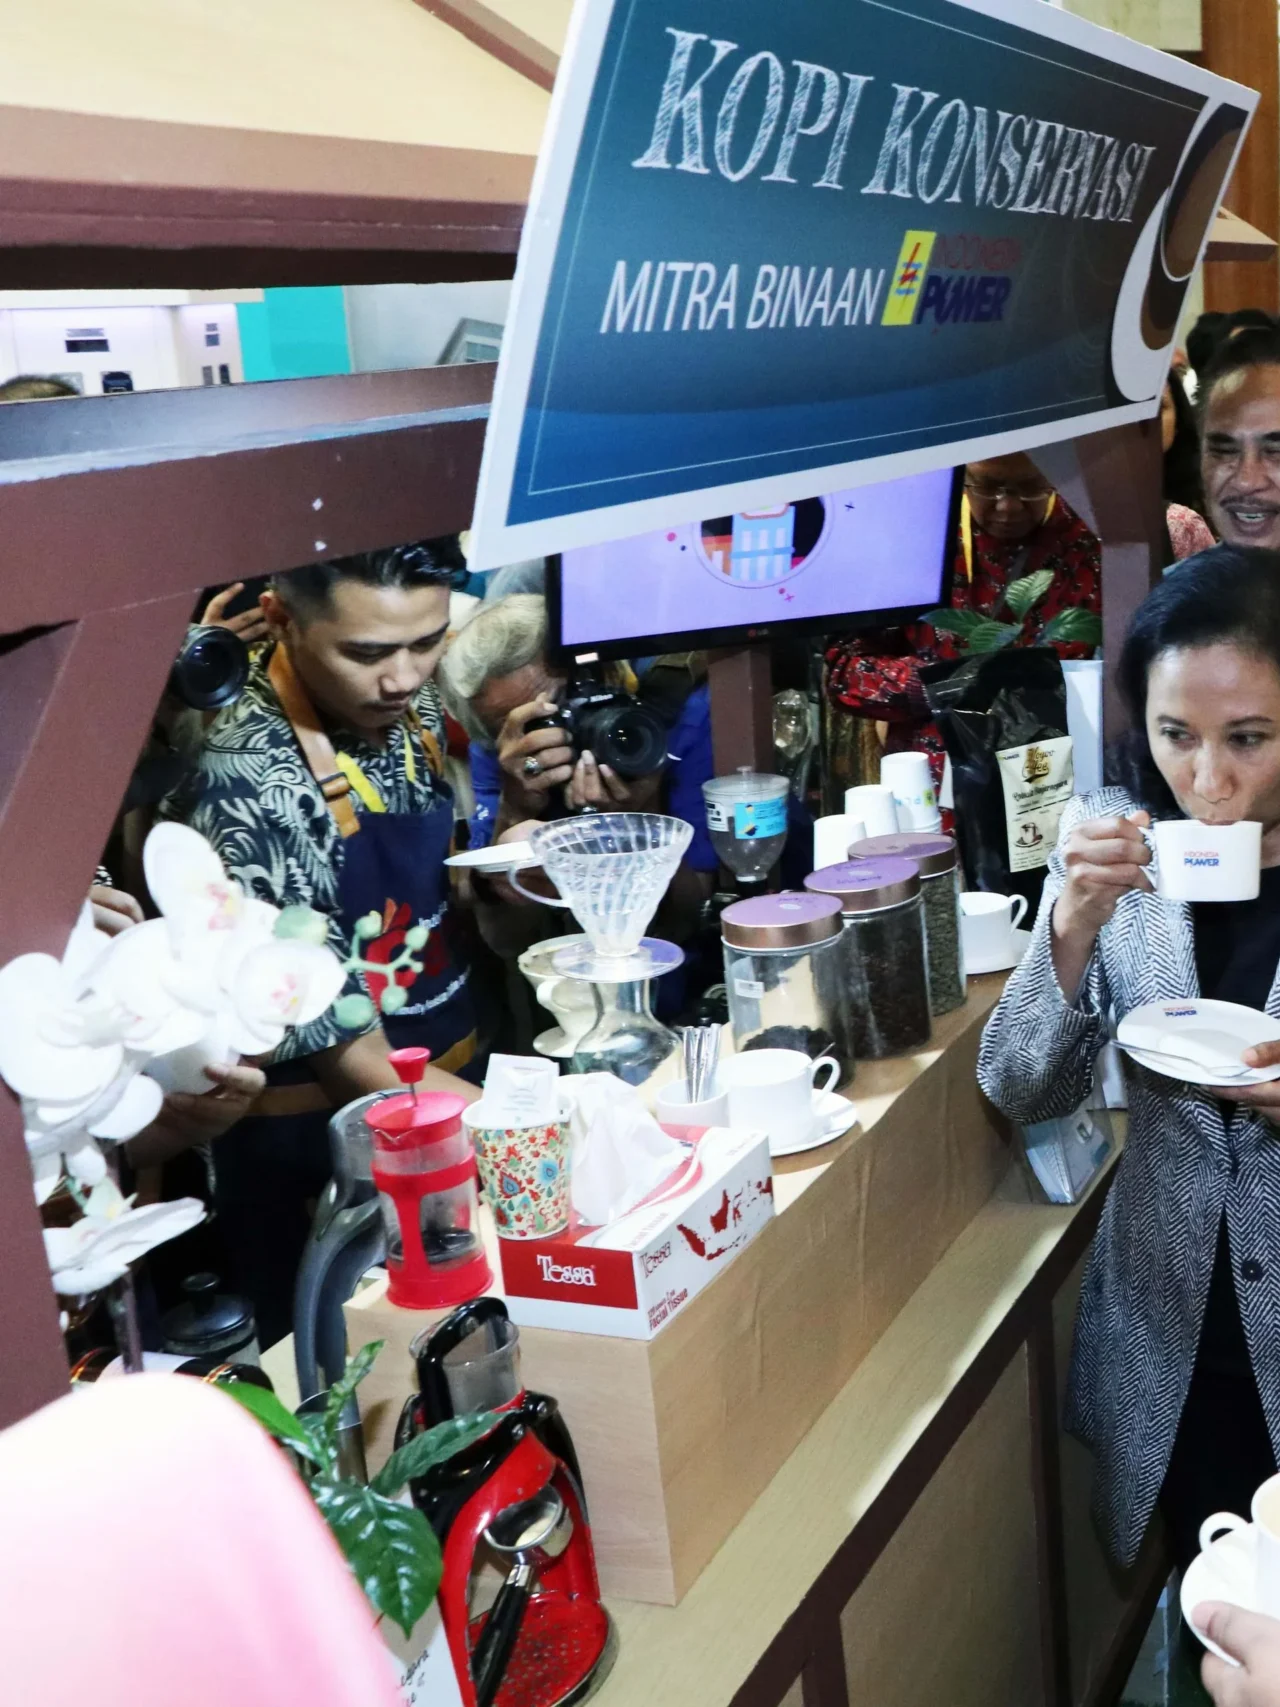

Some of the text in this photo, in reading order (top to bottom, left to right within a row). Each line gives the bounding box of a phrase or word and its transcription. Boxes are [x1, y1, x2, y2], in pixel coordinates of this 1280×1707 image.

[632, 27, 1157, 222] KOPI KONSERVASI
[600, 260, 886, 334] MITRA BINAAN
[915, 275, 1013, 326] POWER
[1184, 858, 1219, 867] POWER
[536, 1254, 597, 1287] Tessa
[640, 1241, 672, 1279] Tessa
[648, 1305, 669, 1332] Facial
[667, 1287, 688, 1313] Tissue
